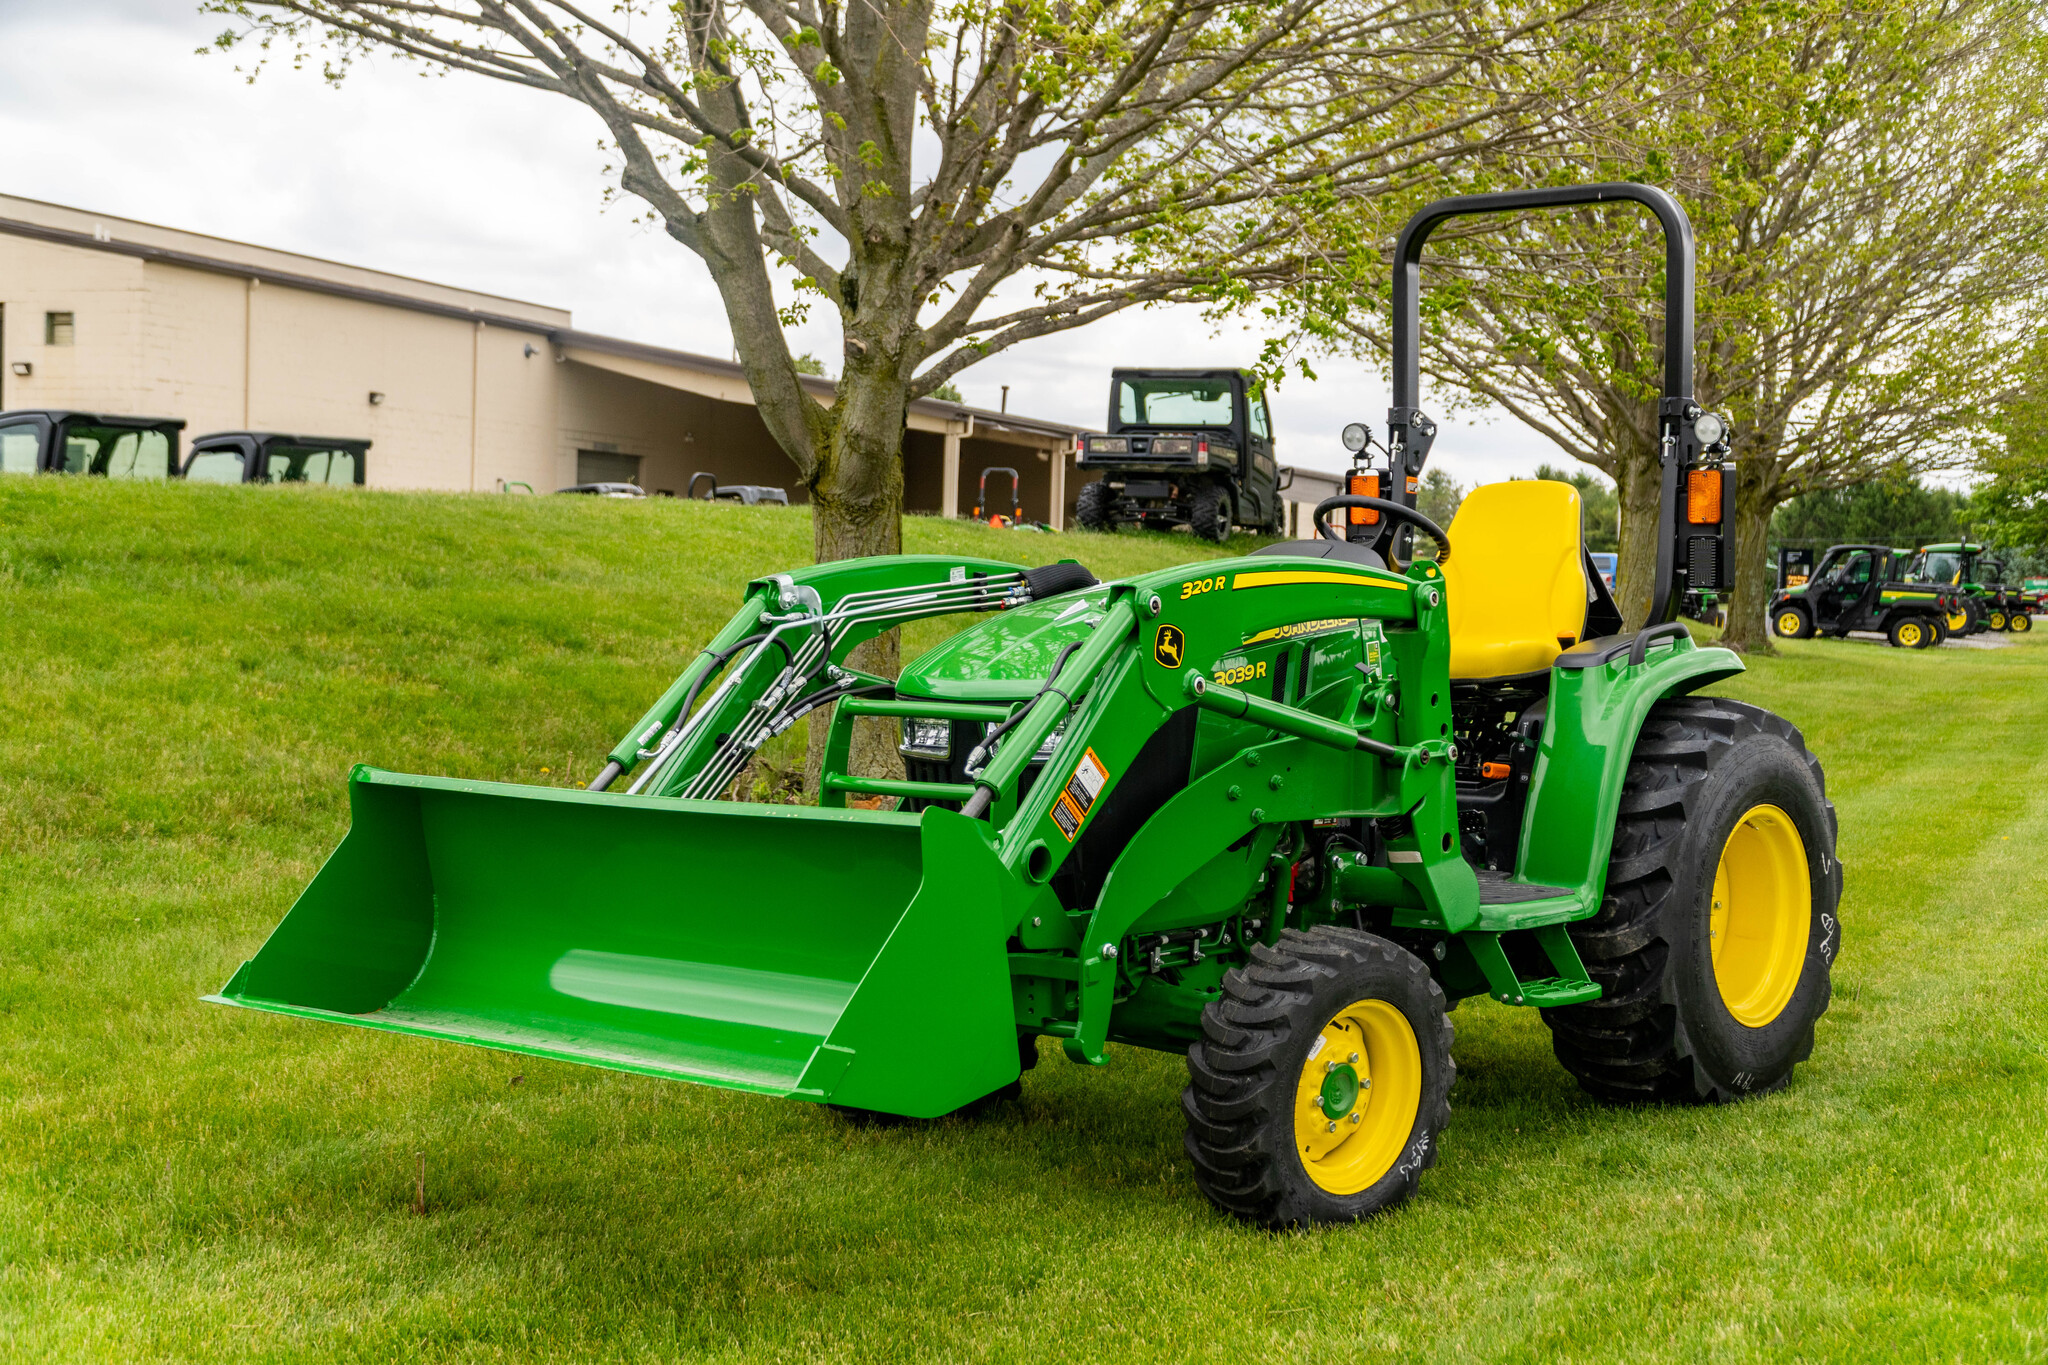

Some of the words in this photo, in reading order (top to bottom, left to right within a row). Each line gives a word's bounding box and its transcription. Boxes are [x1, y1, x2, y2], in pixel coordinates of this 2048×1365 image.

[1180, 578, 1213, 600] 320
[1214, 575, 1226, 591] R
[1274, 621, 1308, 637] JOHN
[1214, 664, 1255, 686] 3039
[1256, 661, 1267, 679] R
